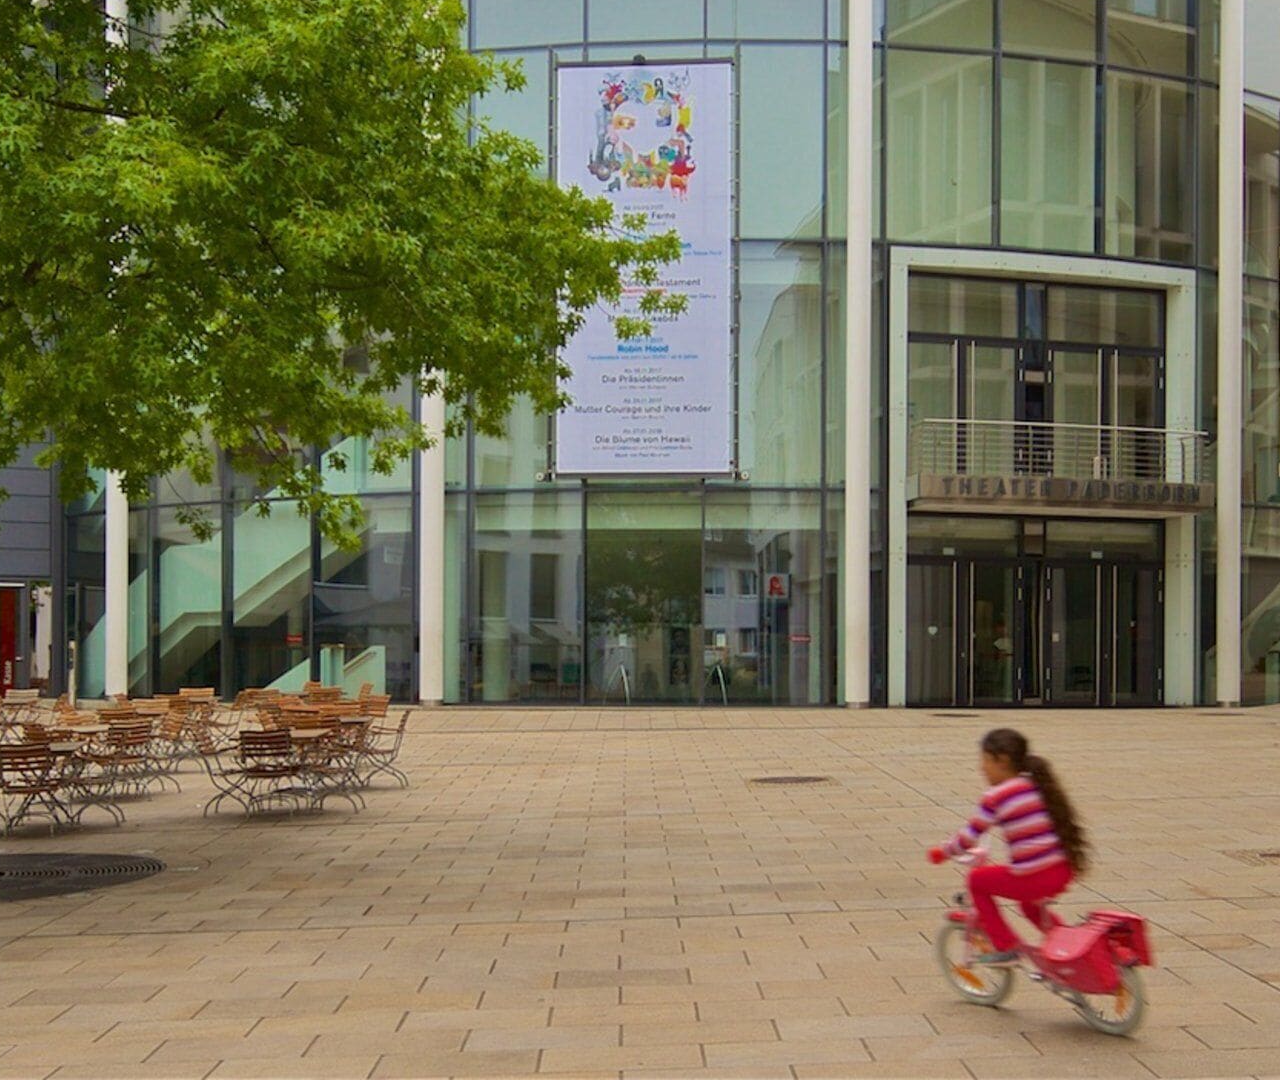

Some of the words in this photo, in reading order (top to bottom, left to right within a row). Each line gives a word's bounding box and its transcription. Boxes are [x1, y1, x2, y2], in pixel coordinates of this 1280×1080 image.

[617, 345, 642, 353] Robin
[645, 345, 669, 353] Hood
[601, 375, 616, 383] Die
[619, 374, 685, 383] Präsidentinnen
[574, 406, 602, 414] Mutter
[604, 405, 642, 414] Courage
[683, 404, 712, 412] Kinder
[595, 435, 609, 444] Die
[612, 435, 641, 443] Blume
[661, 435, 691, 443] Hawaii
[942, 477, 1053, 497] THEATER
[1064, 479, 1201, 503] PADERBORN
